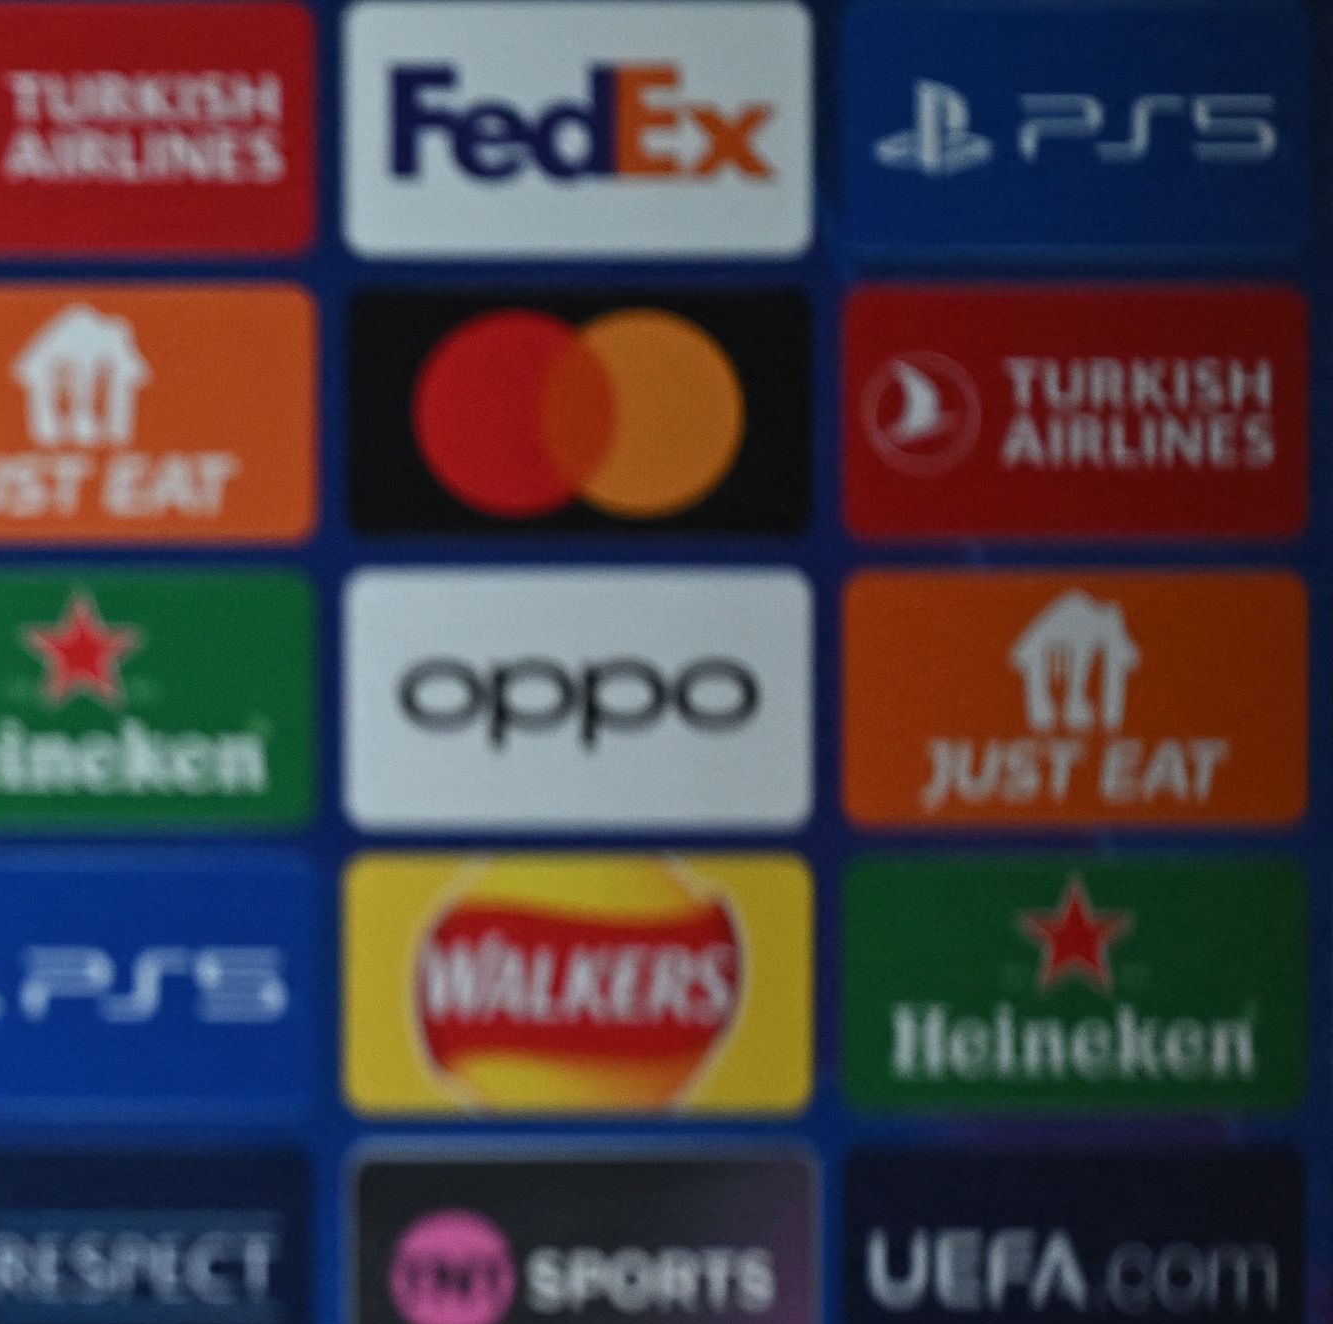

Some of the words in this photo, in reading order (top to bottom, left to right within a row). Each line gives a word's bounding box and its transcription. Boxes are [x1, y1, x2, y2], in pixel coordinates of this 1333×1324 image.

[7, 70, 283, 122] TURKISH
[388, 62, 774, 183] FedEx
[1018, 94, 1277, 161] PS5
[3, 126, 285, 183] AIRLINES
[1004, 357, 1272, 412] TURKISH
[1001, 416, 1275, 468] AIRLINES
[100, 453, 238, 519] EAT
[398, 657, 761, 750] oppo
[921, 739, 1087, 810] JUST
[1097, 739, 1227, 801] EAT
[19, 946, 286, 1023] PS5
[423, 929, 738, 1026] WALKERS
[891, 1004, 1254, 1080] Heineken
[527, 1246, 775, 1313] SPORTS
[867, 1227, 1279, 1311] UEFA.com
